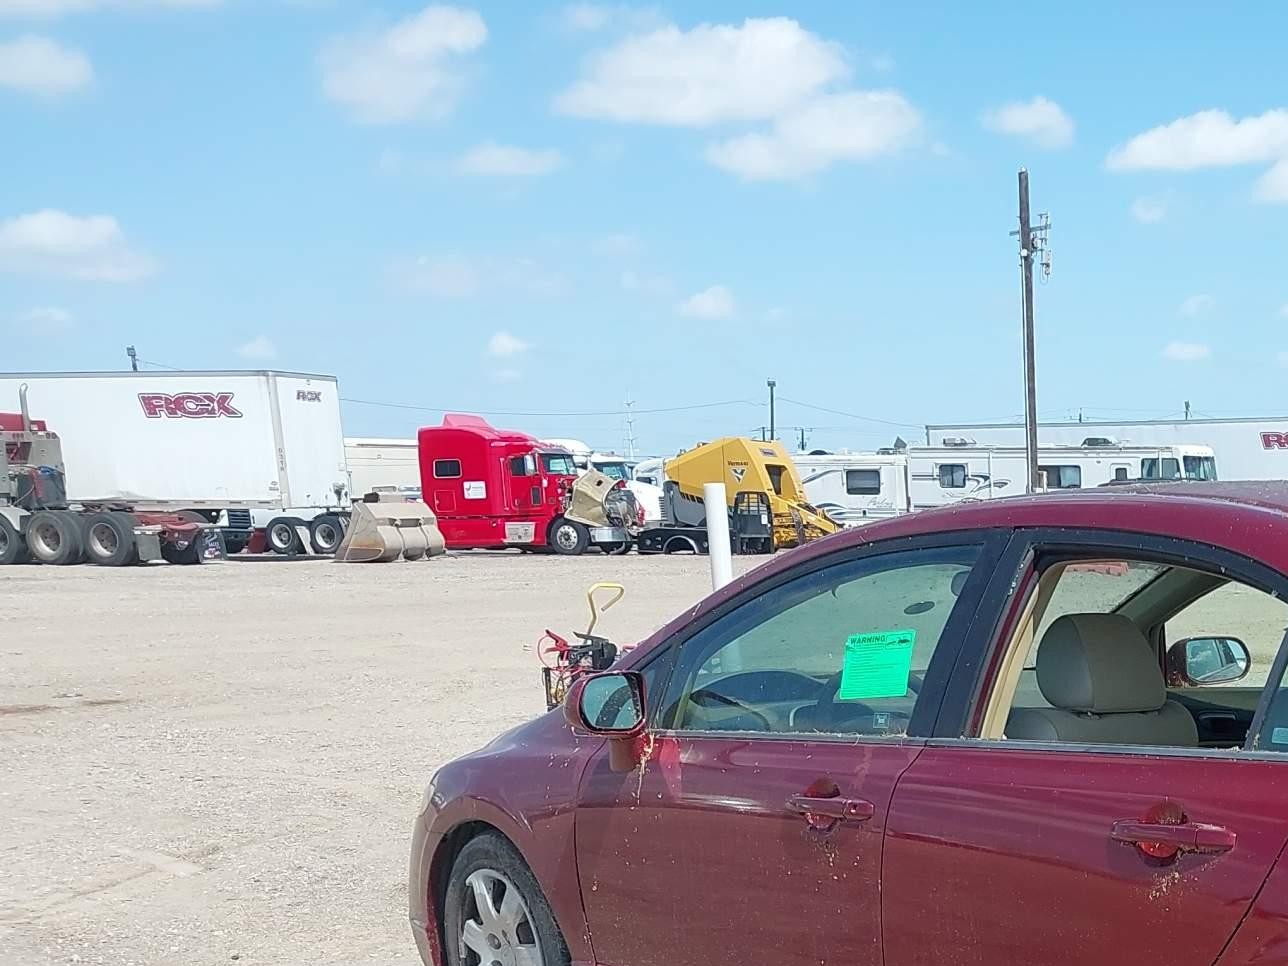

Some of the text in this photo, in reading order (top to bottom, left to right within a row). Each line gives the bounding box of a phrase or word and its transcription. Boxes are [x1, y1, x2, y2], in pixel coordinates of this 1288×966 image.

[296, 389, 322, 403] RCX
[138, 392, 243, 418] RCX
[850, 635, 886, 645] WARNING
